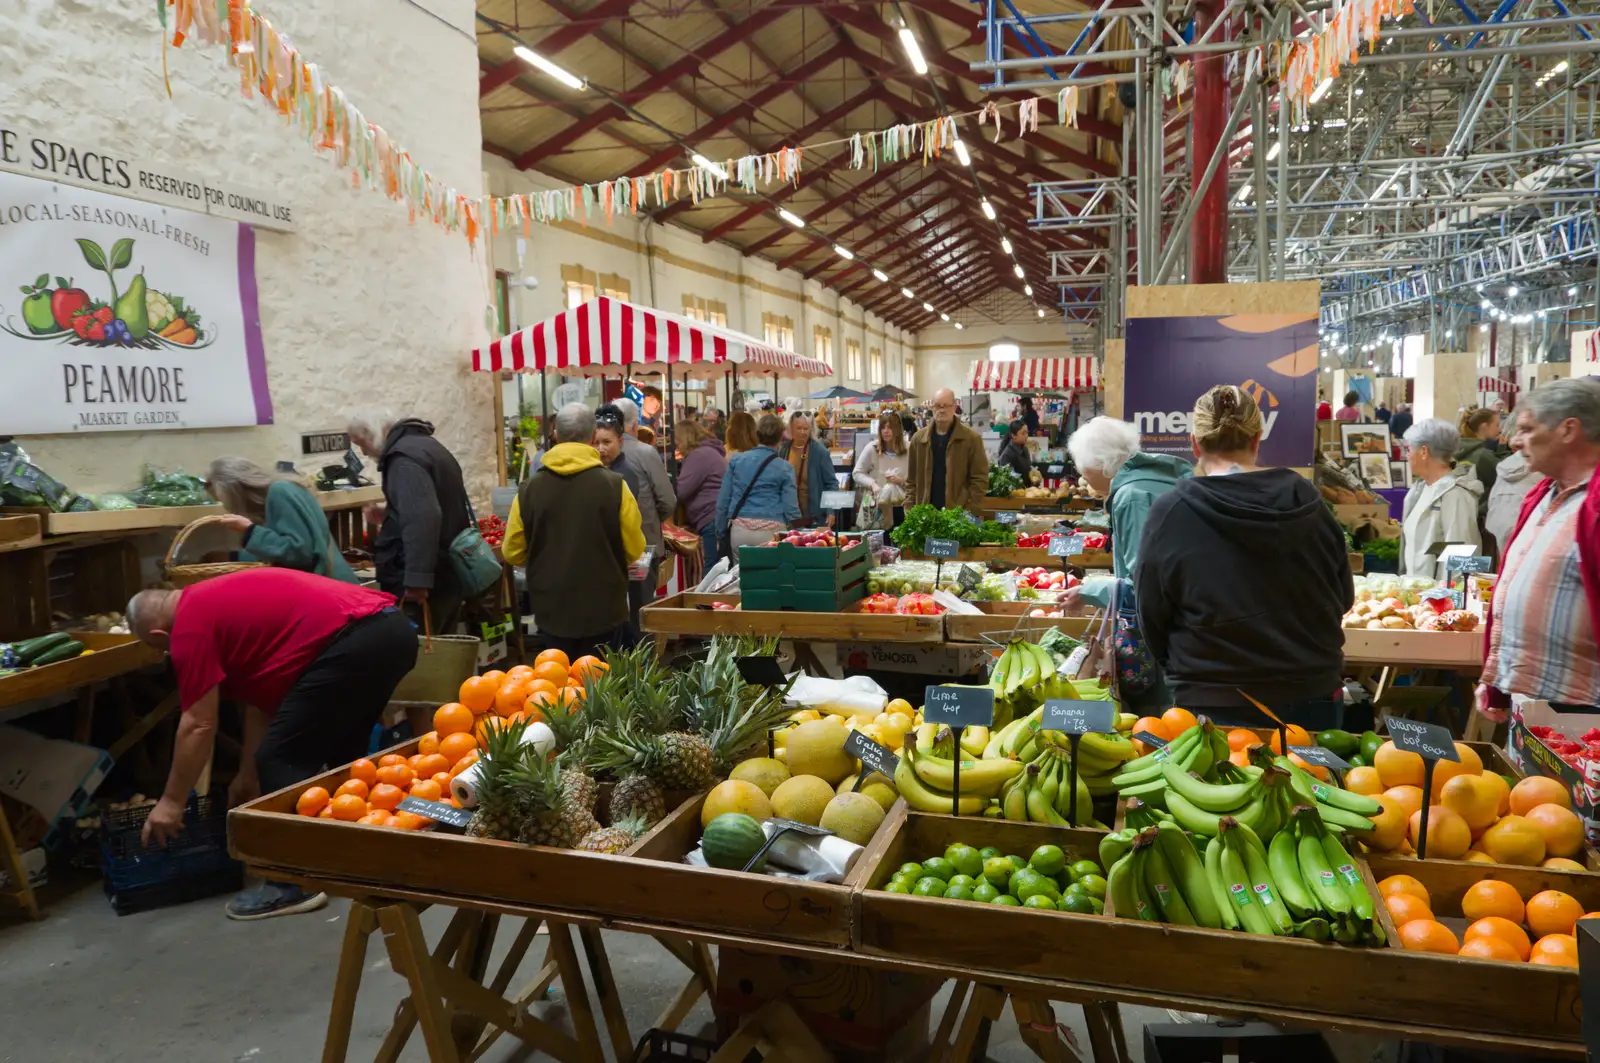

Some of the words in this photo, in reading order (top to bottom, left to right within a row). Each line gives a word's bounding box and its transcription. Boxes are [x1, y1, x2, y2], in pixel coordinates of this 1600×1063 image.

[31, 138, 132, 189] SPACES
[139, 170, 200, 201] RESERVED
[205, 187, 225, 208] FOR
[228, 194, 270, 217] COUNCIL
[273, 206, 292, 223] USE
[62, 363, 187, 404] PEAMORE
[79, 412, 128, 426] MARKET
[133, 411, 179, 425] GARDEN
[871, 650, 918, 665] VENOSTA
[931, 689, 958, 702] Lime
[1051, 705, 1086, 717] Bananas
[1388, 718, 1427, 738] Oranges
